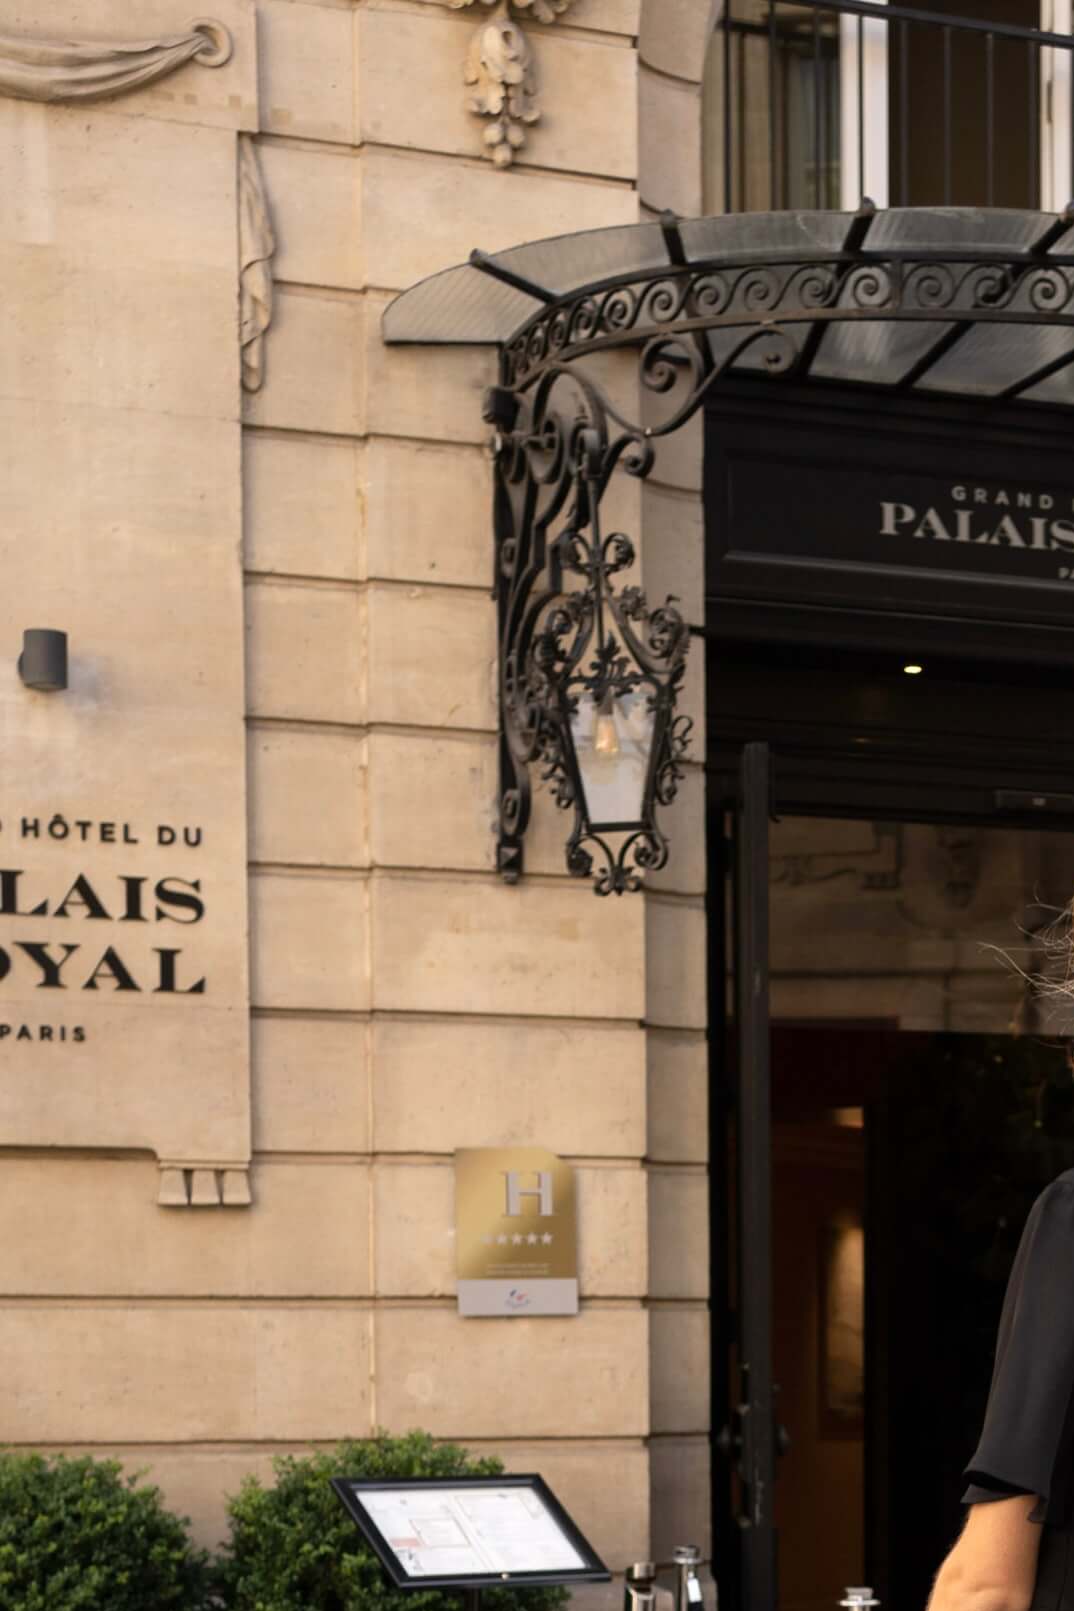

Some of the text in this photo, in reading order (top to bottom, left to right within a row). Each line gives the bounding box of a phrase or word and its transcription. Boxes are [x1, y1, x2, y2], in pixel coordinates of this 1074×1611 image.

[951, 485, 1055, 510] GRAND
[21, 814, 139, 845] HÔTEL
[157, 825, 202, 848] DU
[0, 940, 206, 994] YAL
[0, 1024, 86, 1043] PARIS
[506, 1171, 553, 1217] H
